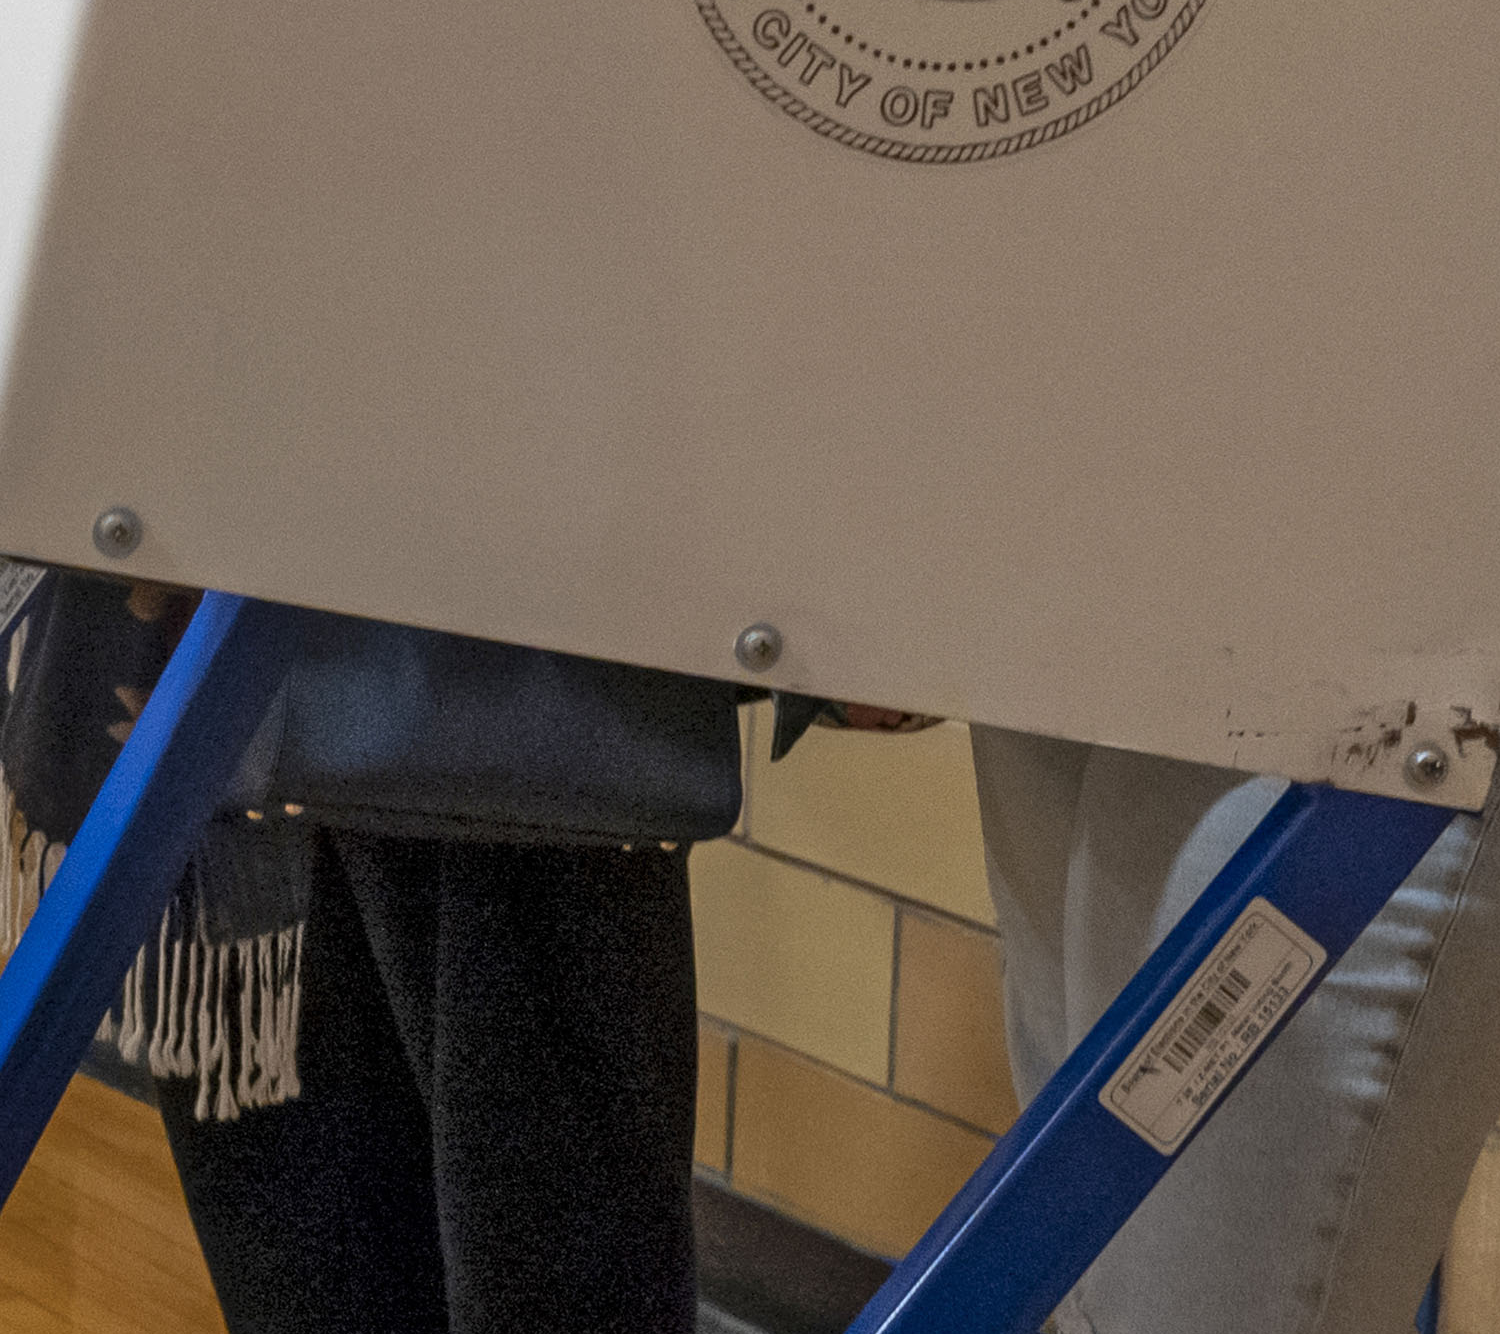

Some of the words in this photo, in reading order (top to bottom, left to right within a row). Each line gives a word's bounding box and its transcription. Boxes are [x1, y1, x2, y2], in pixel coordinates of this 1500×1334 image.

[752, 9, 872, 109] CITY
[880, 85, 954, 128] OF
[973, 46, 1094, 127] NEW
